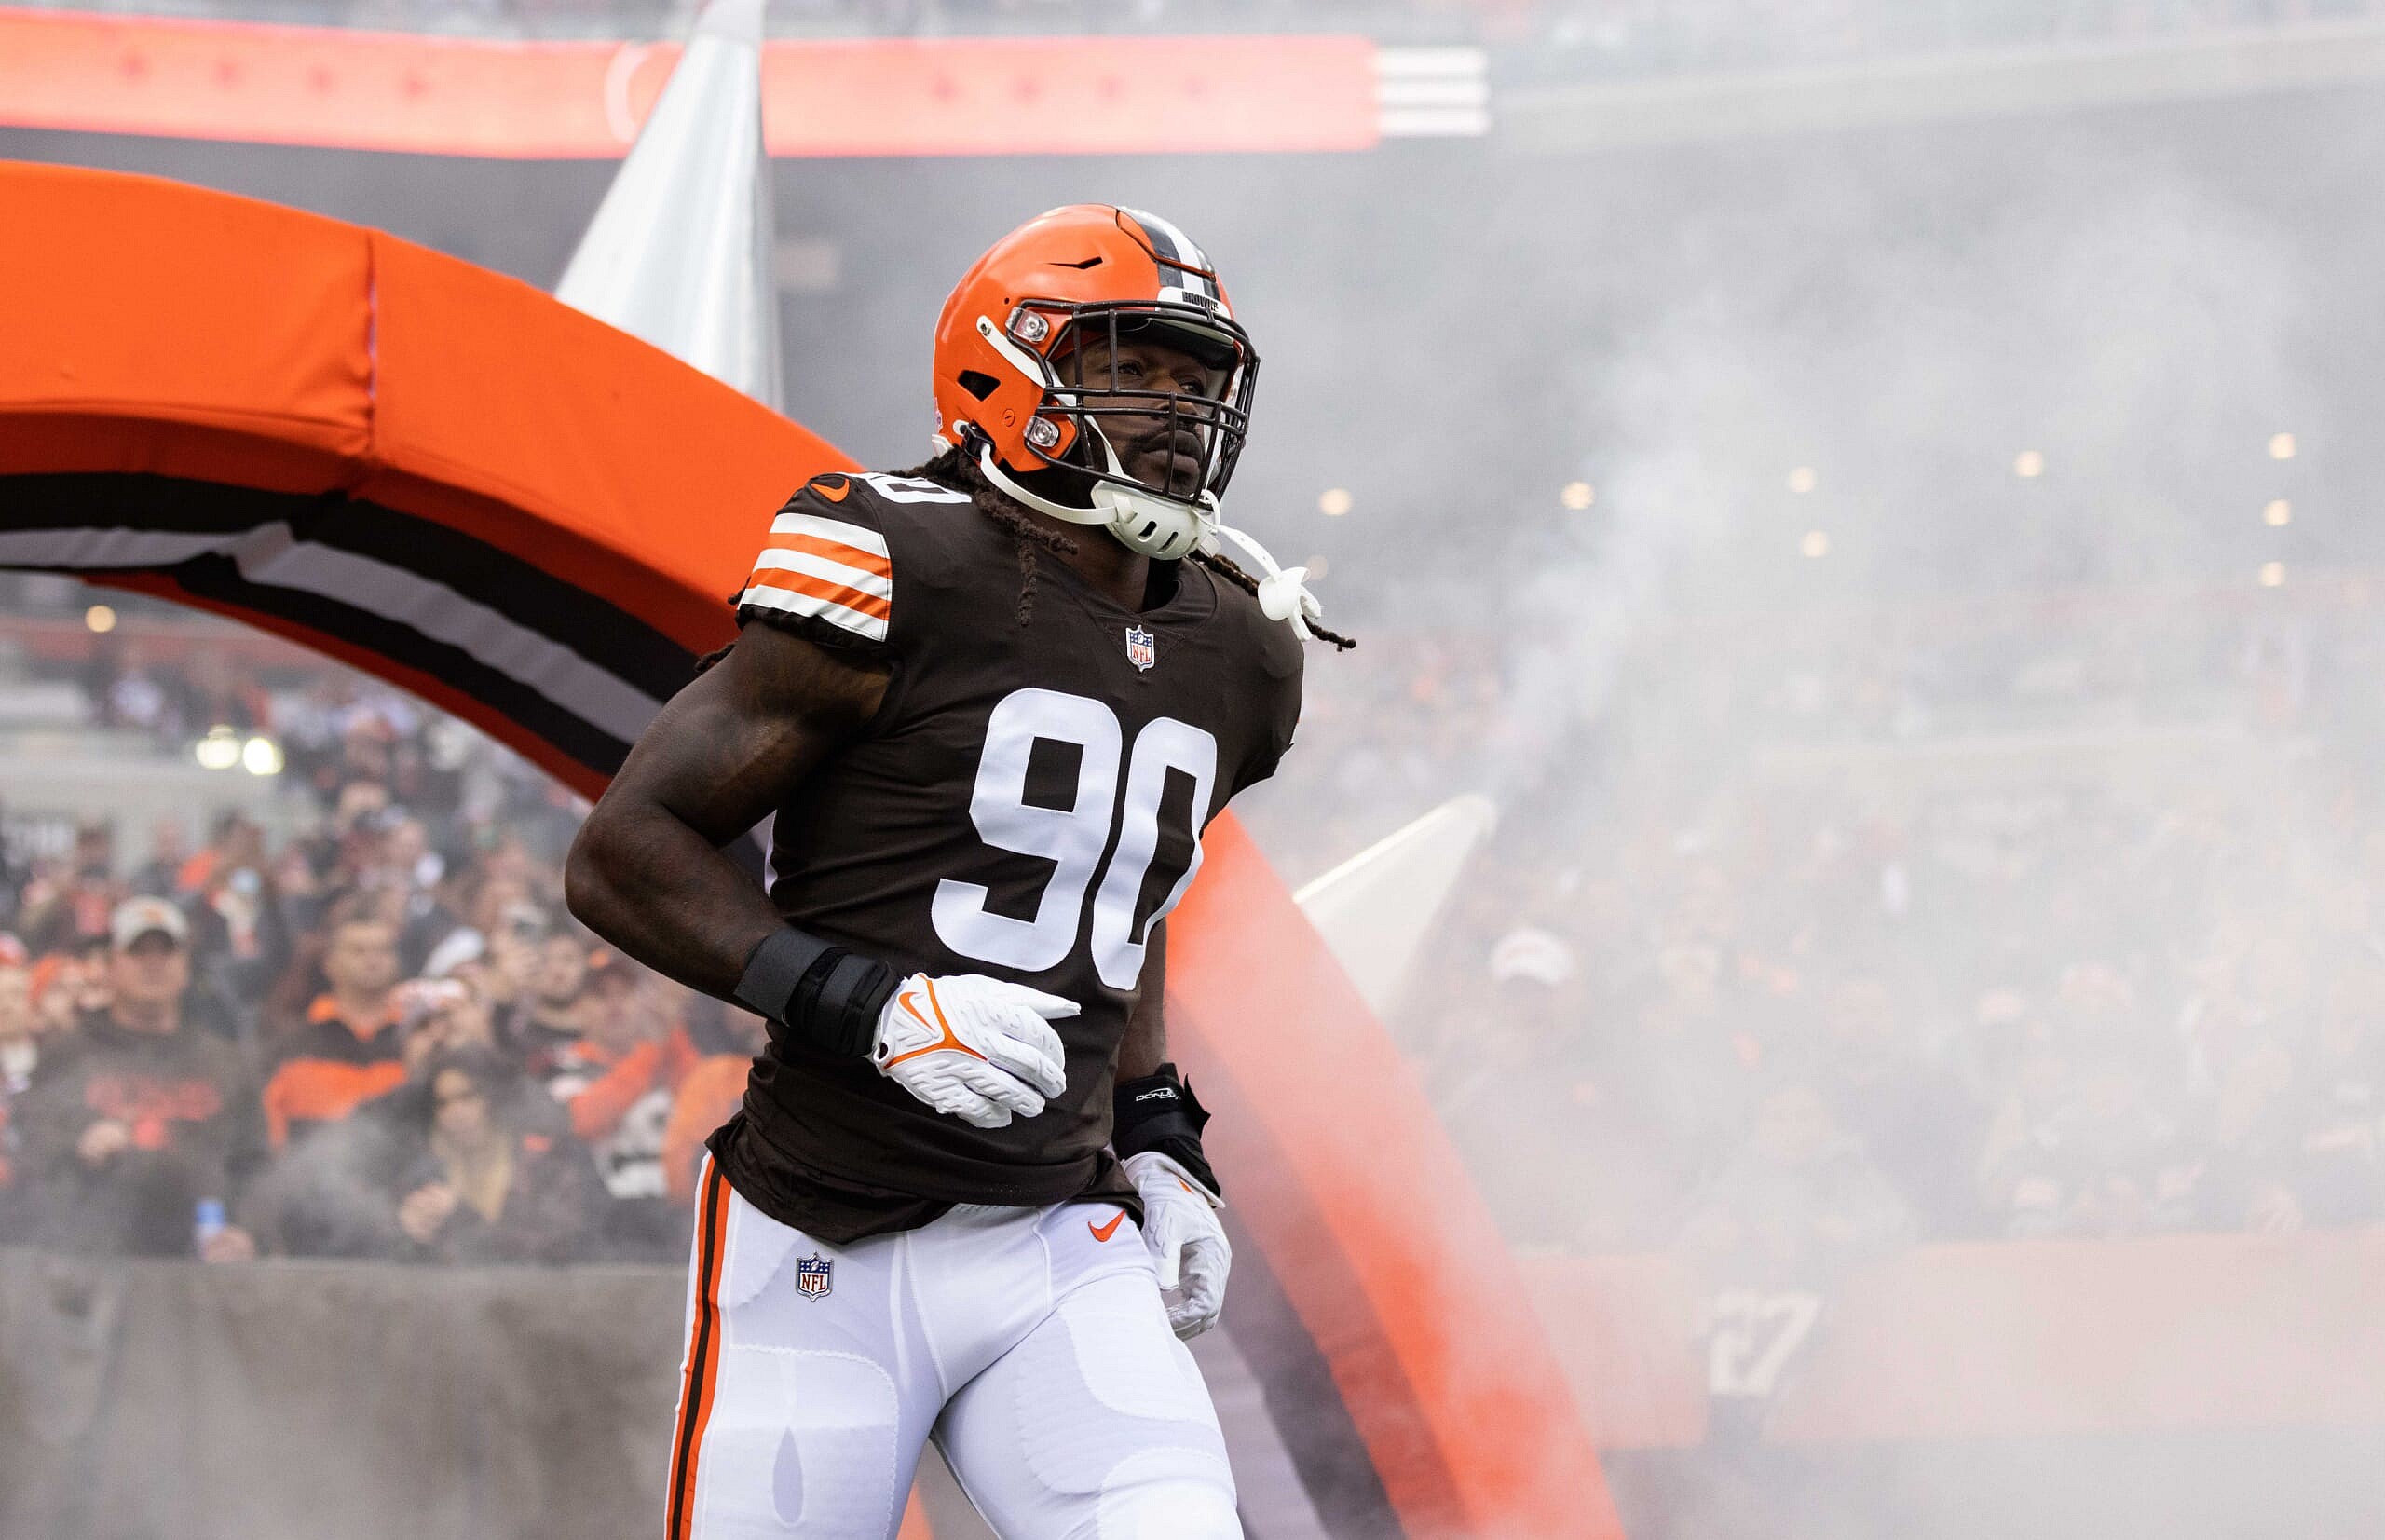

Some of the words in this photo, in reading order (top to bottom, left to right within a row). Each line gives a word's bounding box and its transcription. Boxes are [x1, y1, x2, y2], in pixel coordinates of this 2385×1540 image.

[1132, 644, 1151, 662] NFL
[931, 687, 1218, 991] 90
[801, 1274, 826, 1292] NFL
